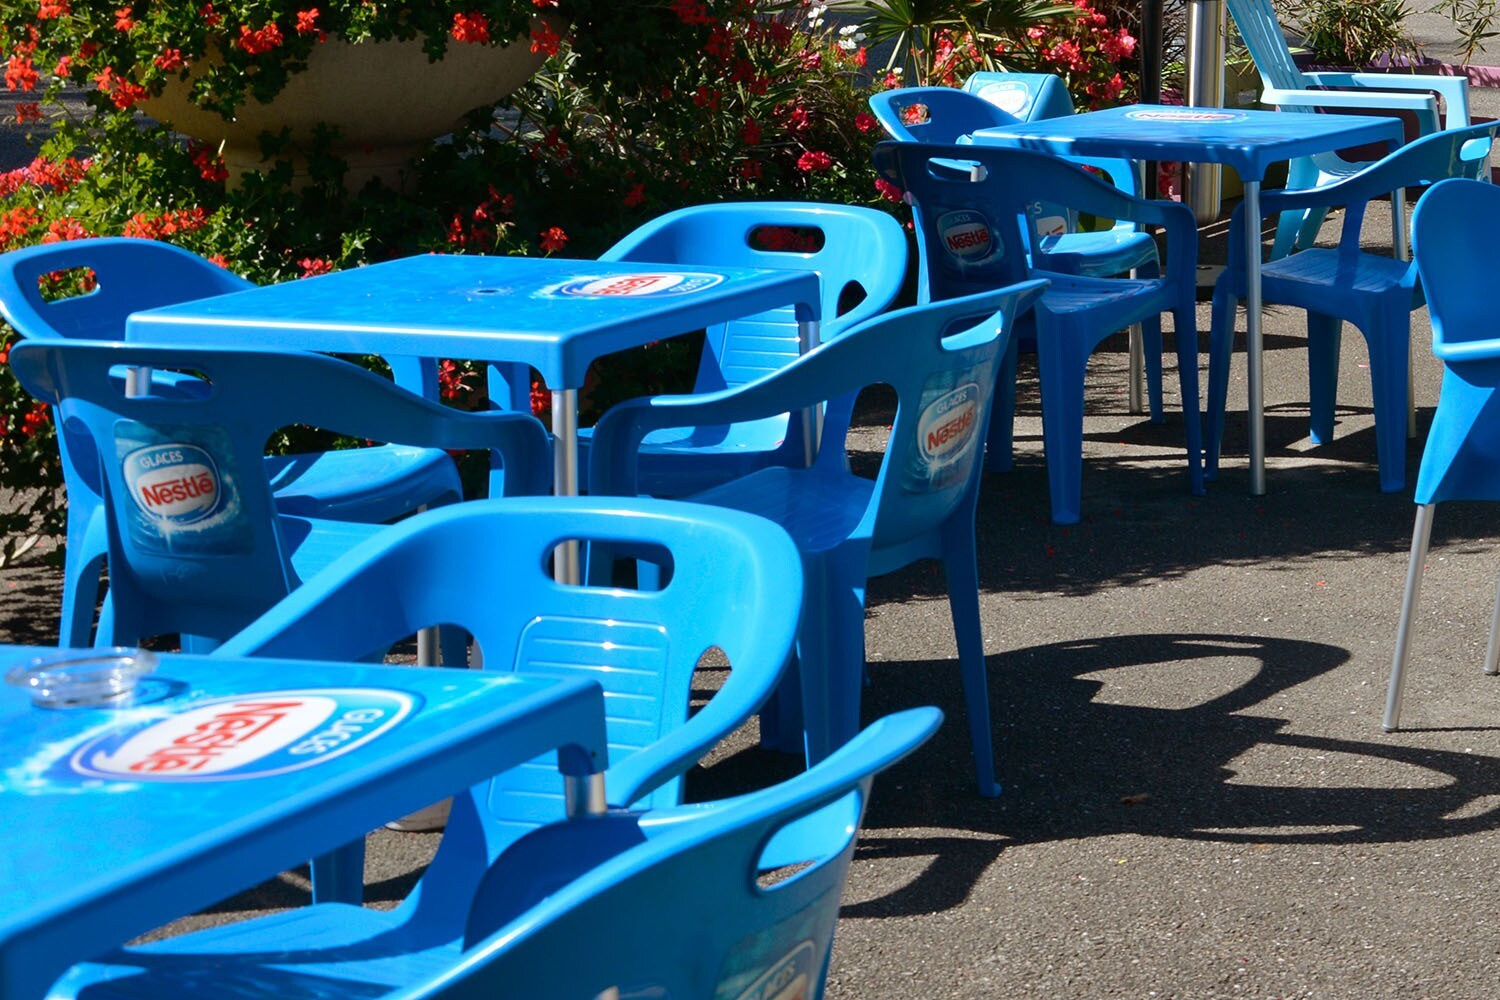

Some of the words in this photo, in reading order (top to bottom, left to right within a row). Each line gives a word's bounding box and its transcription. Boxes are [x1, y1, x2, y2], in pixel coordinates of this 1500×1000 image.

[946, 219, 989, 251] Nestlé
[936, 391, 968, 414] GLACES
[925, 406, 975, 451] Nestlé
[140, 450, 184, 469] GLACES
[141, 471, 215, 508] Nestlé
[127, 702, 303, 772] Nestlé
[288, 708, 385, 756] GLACES
